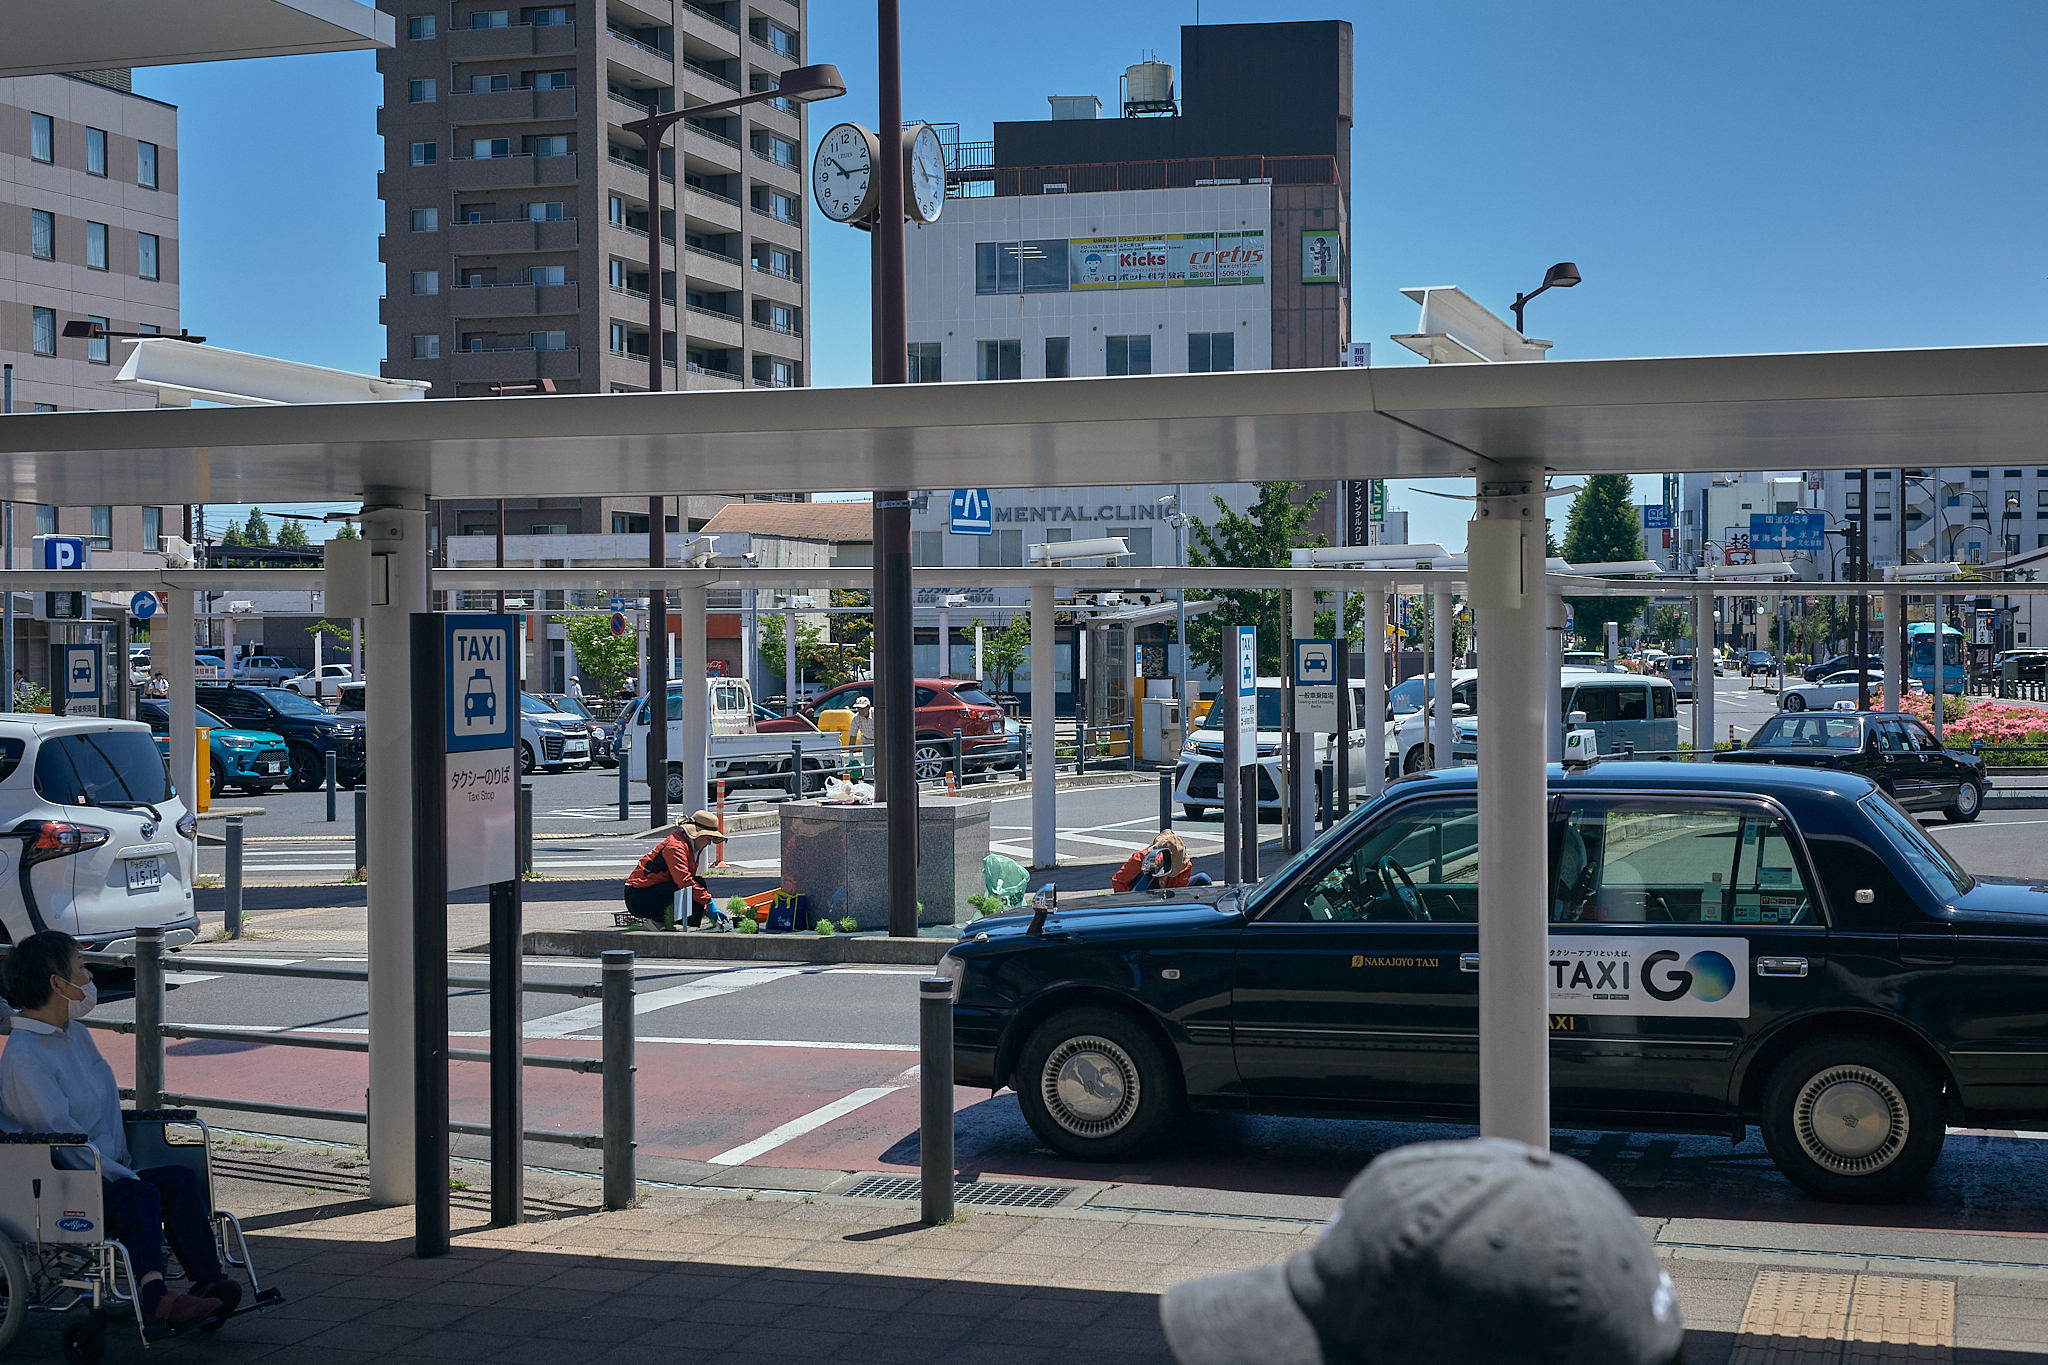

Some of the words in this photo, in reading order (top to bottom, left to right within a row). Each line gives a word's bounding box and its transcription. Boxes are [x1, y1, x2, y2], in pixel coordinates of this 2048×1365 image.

[841, 134, 849, 144] 12
[831, 142, 838, 153] 11
[860, 148, 866, 157] 2
[824, 157, 832, 167] 10
[822, 172, 829, 182] 9
[860, 181, 866, 190] 4
[825, 188, 831, 198] 8
[833, 200, 839, 210] 7
[854, 196, 860, 205] 5
[842, 203, 849, 213] 6
[1120, 252, 1166, 267] Kicks
[1354, 347, 1364, 366] 那珂
[1765, 515, 1809, 525] 国道245号
[1751, 534, 1770, 542] 東海
[1799, 531, 1820, 539] 水戸
[1798, 539, 1823, 547] 文化会館
[56, 542, 75, 569] P
[457, 635, 501, 661] TAXI
[1241, 637, 1253, 651] TAXI
[452, 766, 510, 789] タクシーのりば
[468, 791, 480, 801] Taxi
[481, 790, 494, 801] Stop
[136, 870, 159, 886] 15-15
[1549, 949, 1632, 957] タクシーアプリといえば、
[1364, 957, 1414, 967] NAKAJOYO
[1416, 958, 1439, 967] TAXI
[1549, 960, 1630, 990] TAXI
